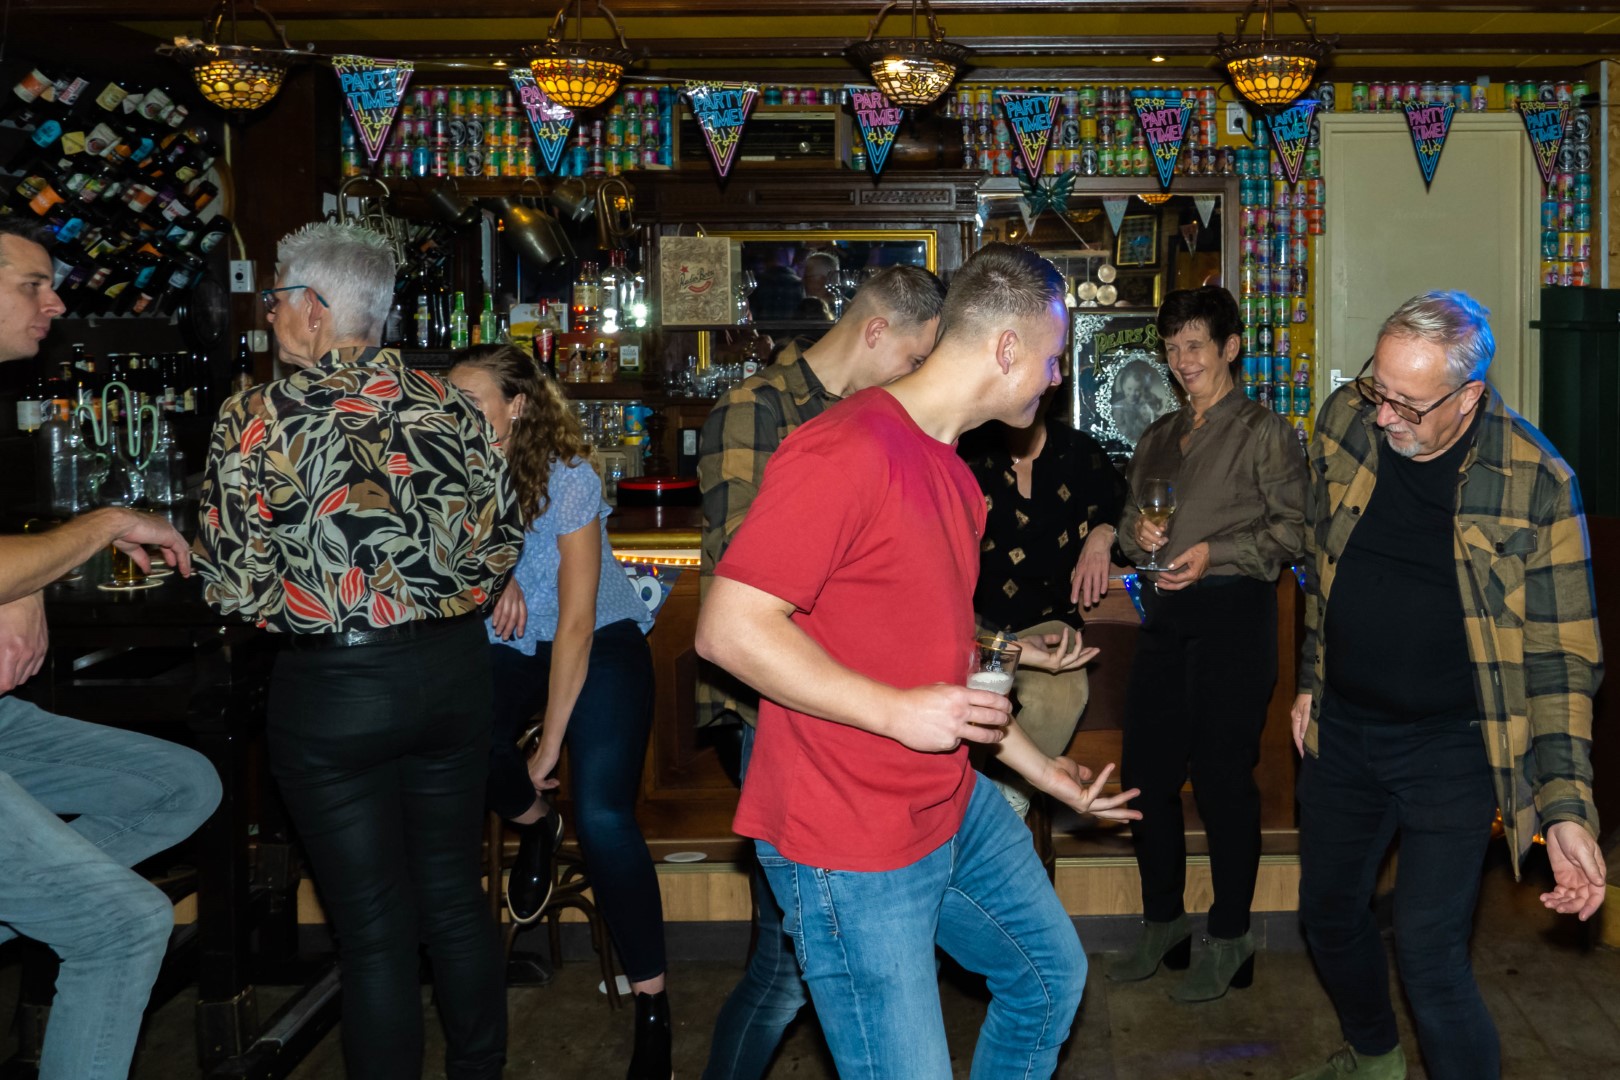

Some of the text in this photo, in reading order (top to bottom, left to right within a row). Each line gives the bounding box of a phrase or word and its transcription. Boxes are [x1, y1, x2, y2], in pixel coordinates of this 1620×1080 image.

[341, 69, 397, 92] PARTY
[347, 89, 399, 110] TIME!
[693, 90, 743, 112] PARTY
[852, 92, 889, 110] PAR
[1005, 96, 1049, 118] PARTY
[699, 108, 744, 129] TIME!
[857, 108, 901, 126] TIME!
[1011, 113, 1052, 134] TIME!
[1140, 108, 1182, 128] PARTY
[1407, 107, 1445, 126] PARTY
[1527, 109, 1560, 129] PARTY
[1146, 124, 1183, 144] TIME!
[1272, 121, 1308, 143] TIME!
[1412, 122, 1446, 141] TIME!
[1530, 124, 1563, 144] TIME!
[1094, 328, 1143, 375] PEARS
